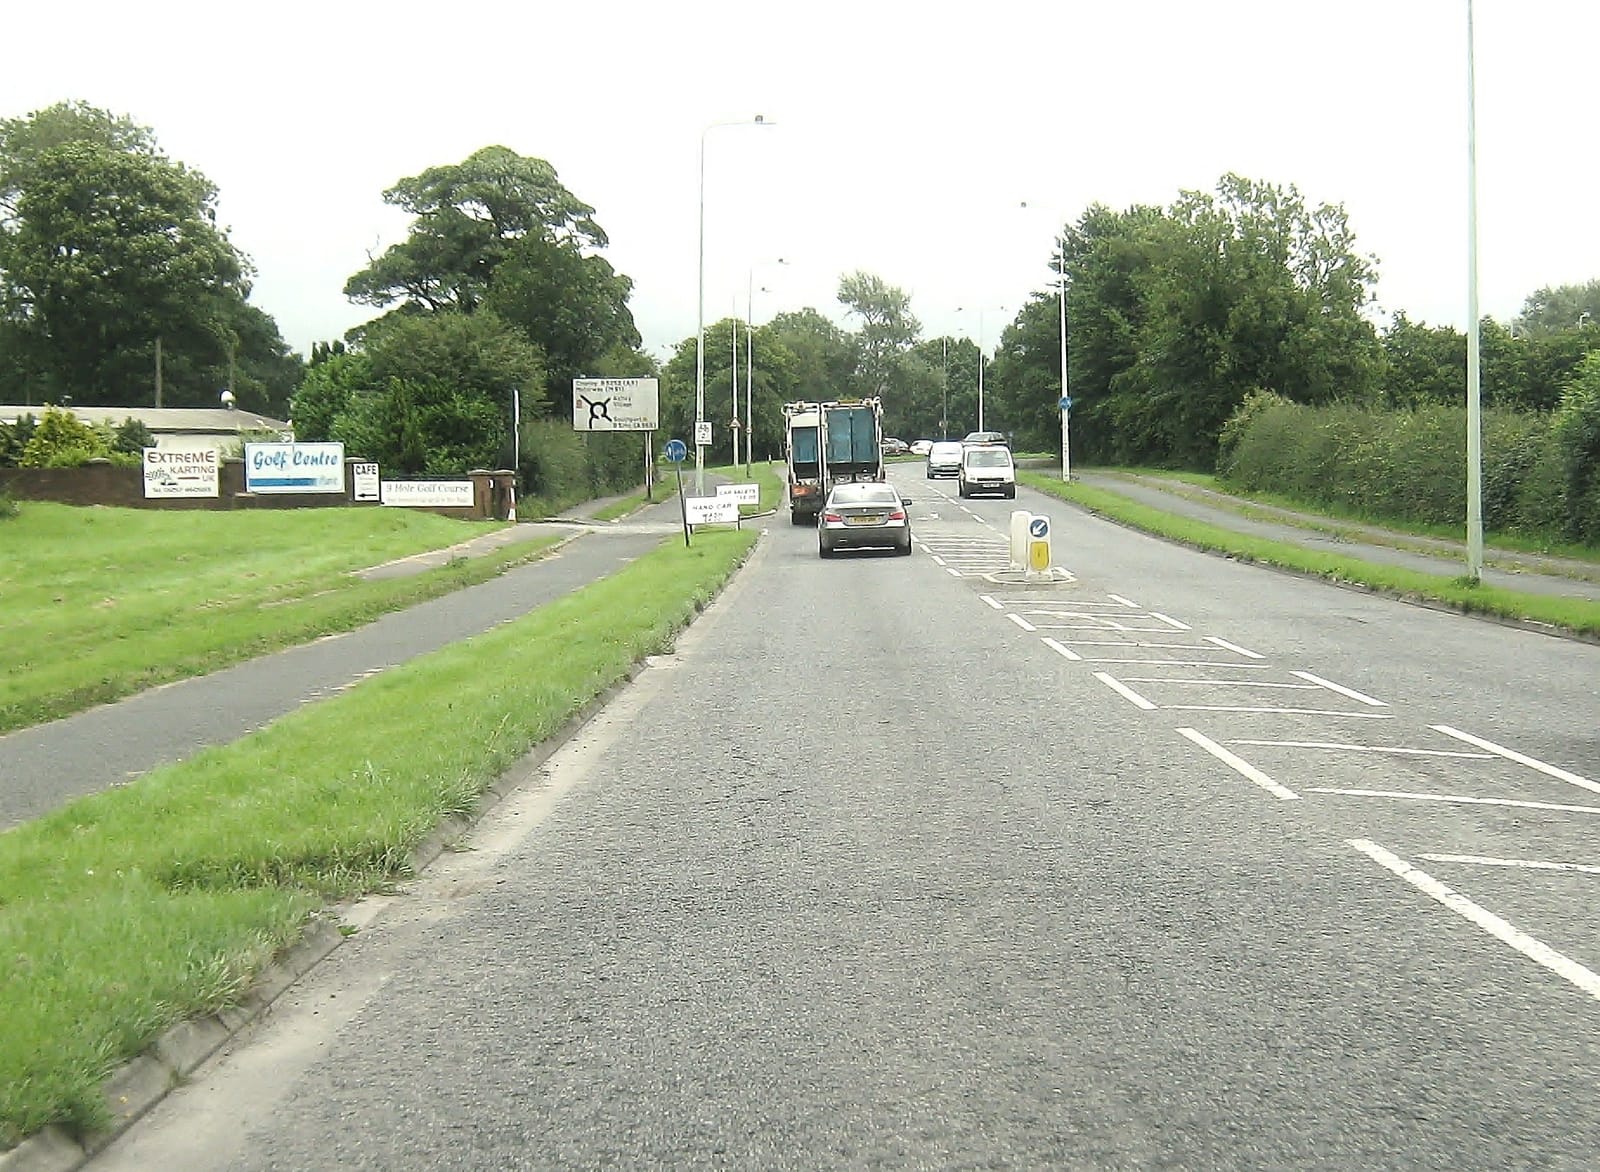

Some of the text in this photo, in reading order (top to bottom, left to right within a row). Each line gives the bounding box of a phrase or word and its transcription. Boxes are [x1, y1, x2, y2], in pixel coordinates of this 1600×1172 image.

[148, 451, 215, 463] EXTREME
[254, 451, 338, 470] Golf Centre
[170, 466, 215, 474] KARTING
[356, 465, 377, 475] CAFE
[418, 484, 437, 492] Golf
[438, 484, 469, 492] Course
